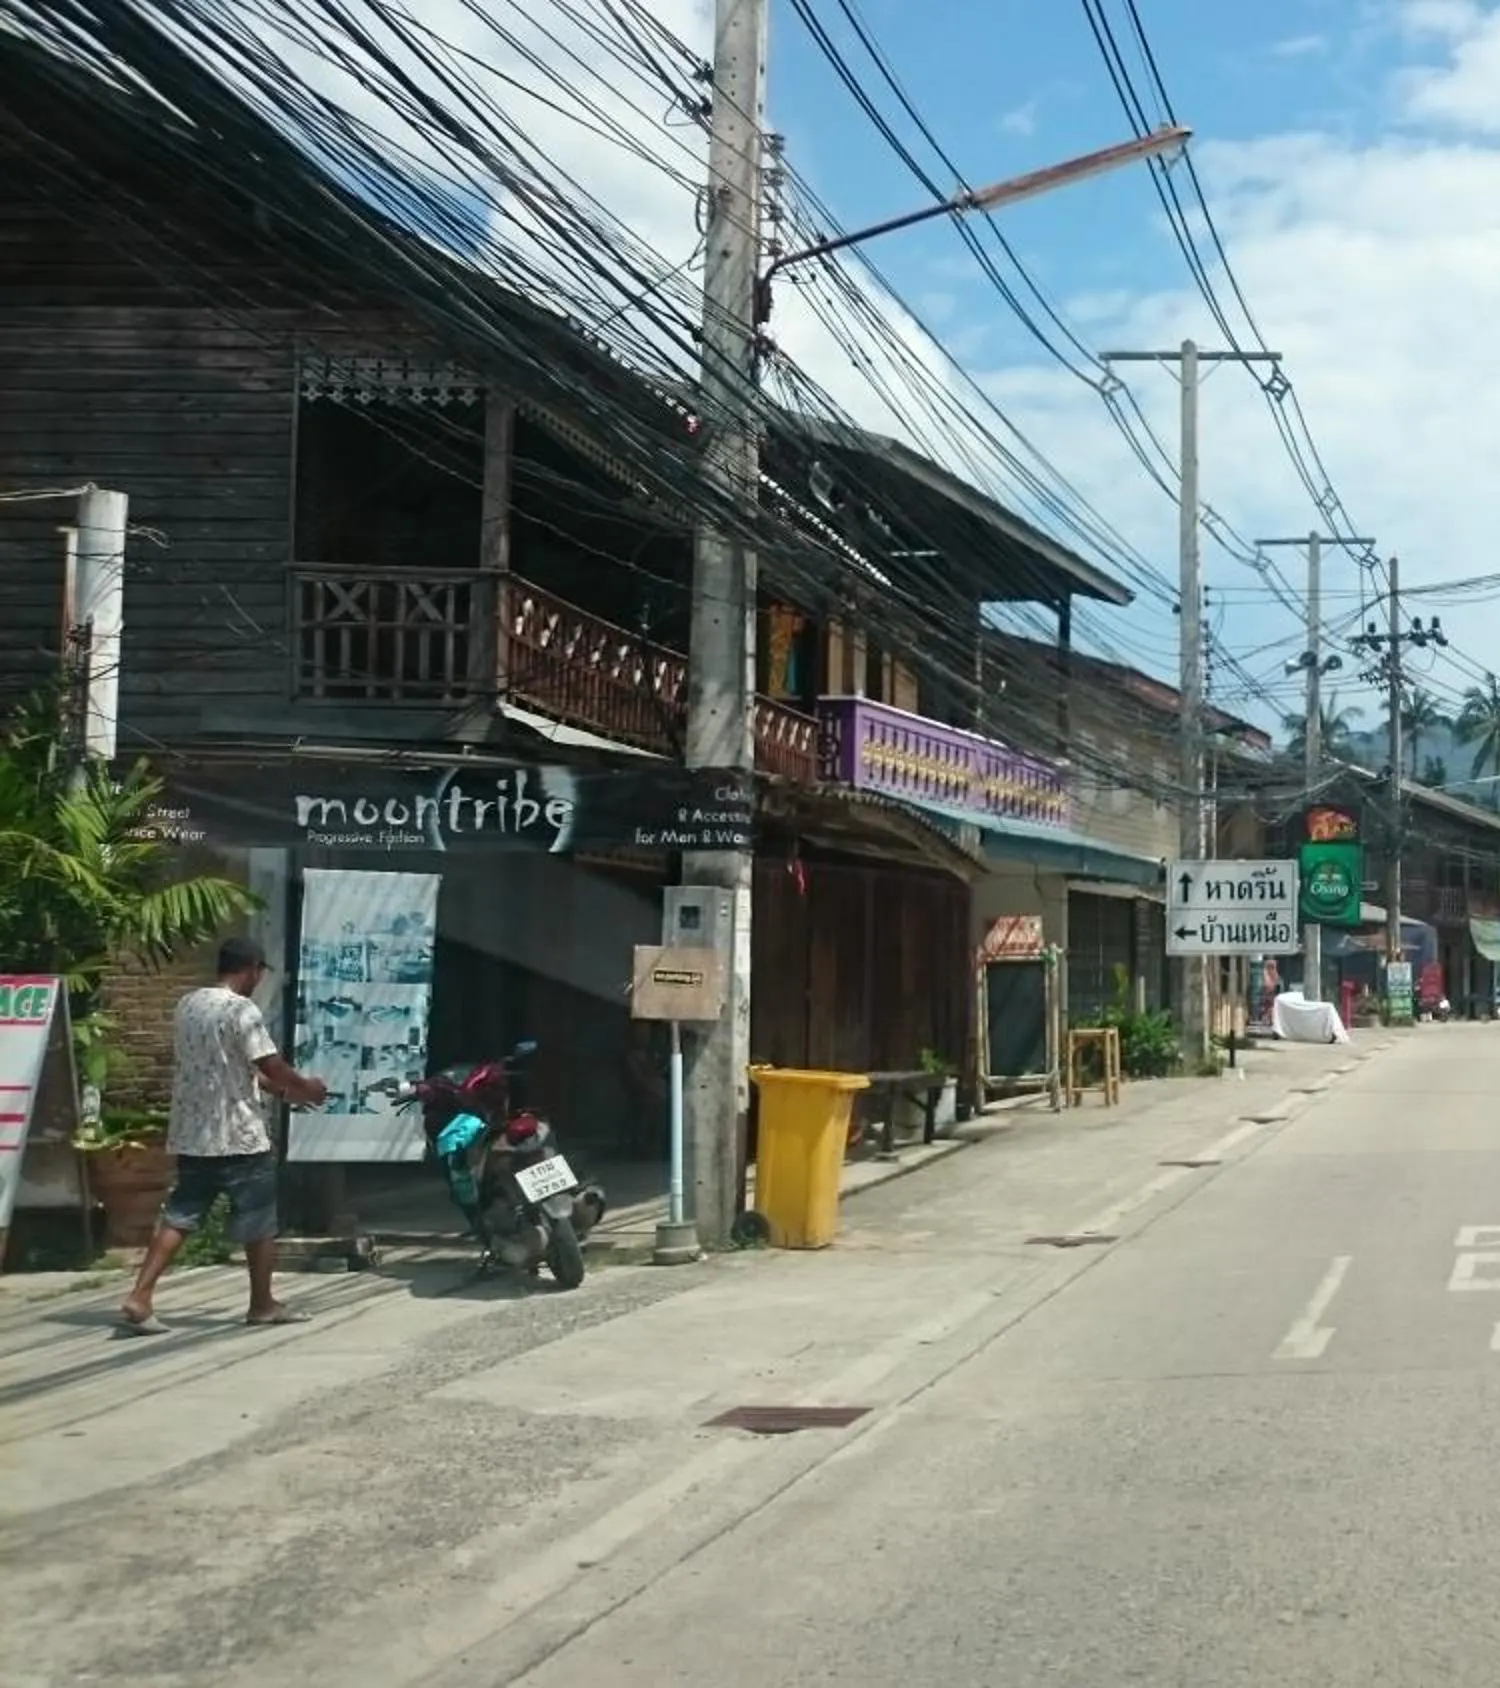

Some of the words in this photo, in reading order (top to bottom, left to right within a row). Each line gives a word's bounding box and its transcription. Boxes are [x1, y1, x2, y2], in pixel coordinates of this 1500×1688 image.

[295, 769, 573, 834] moontribe
[307, 829, 374, 846] Progressive
[1205, 866, 1287, 900] หาดริ้น
[1201, 911, 1291, 943] บ้านเหนือ
